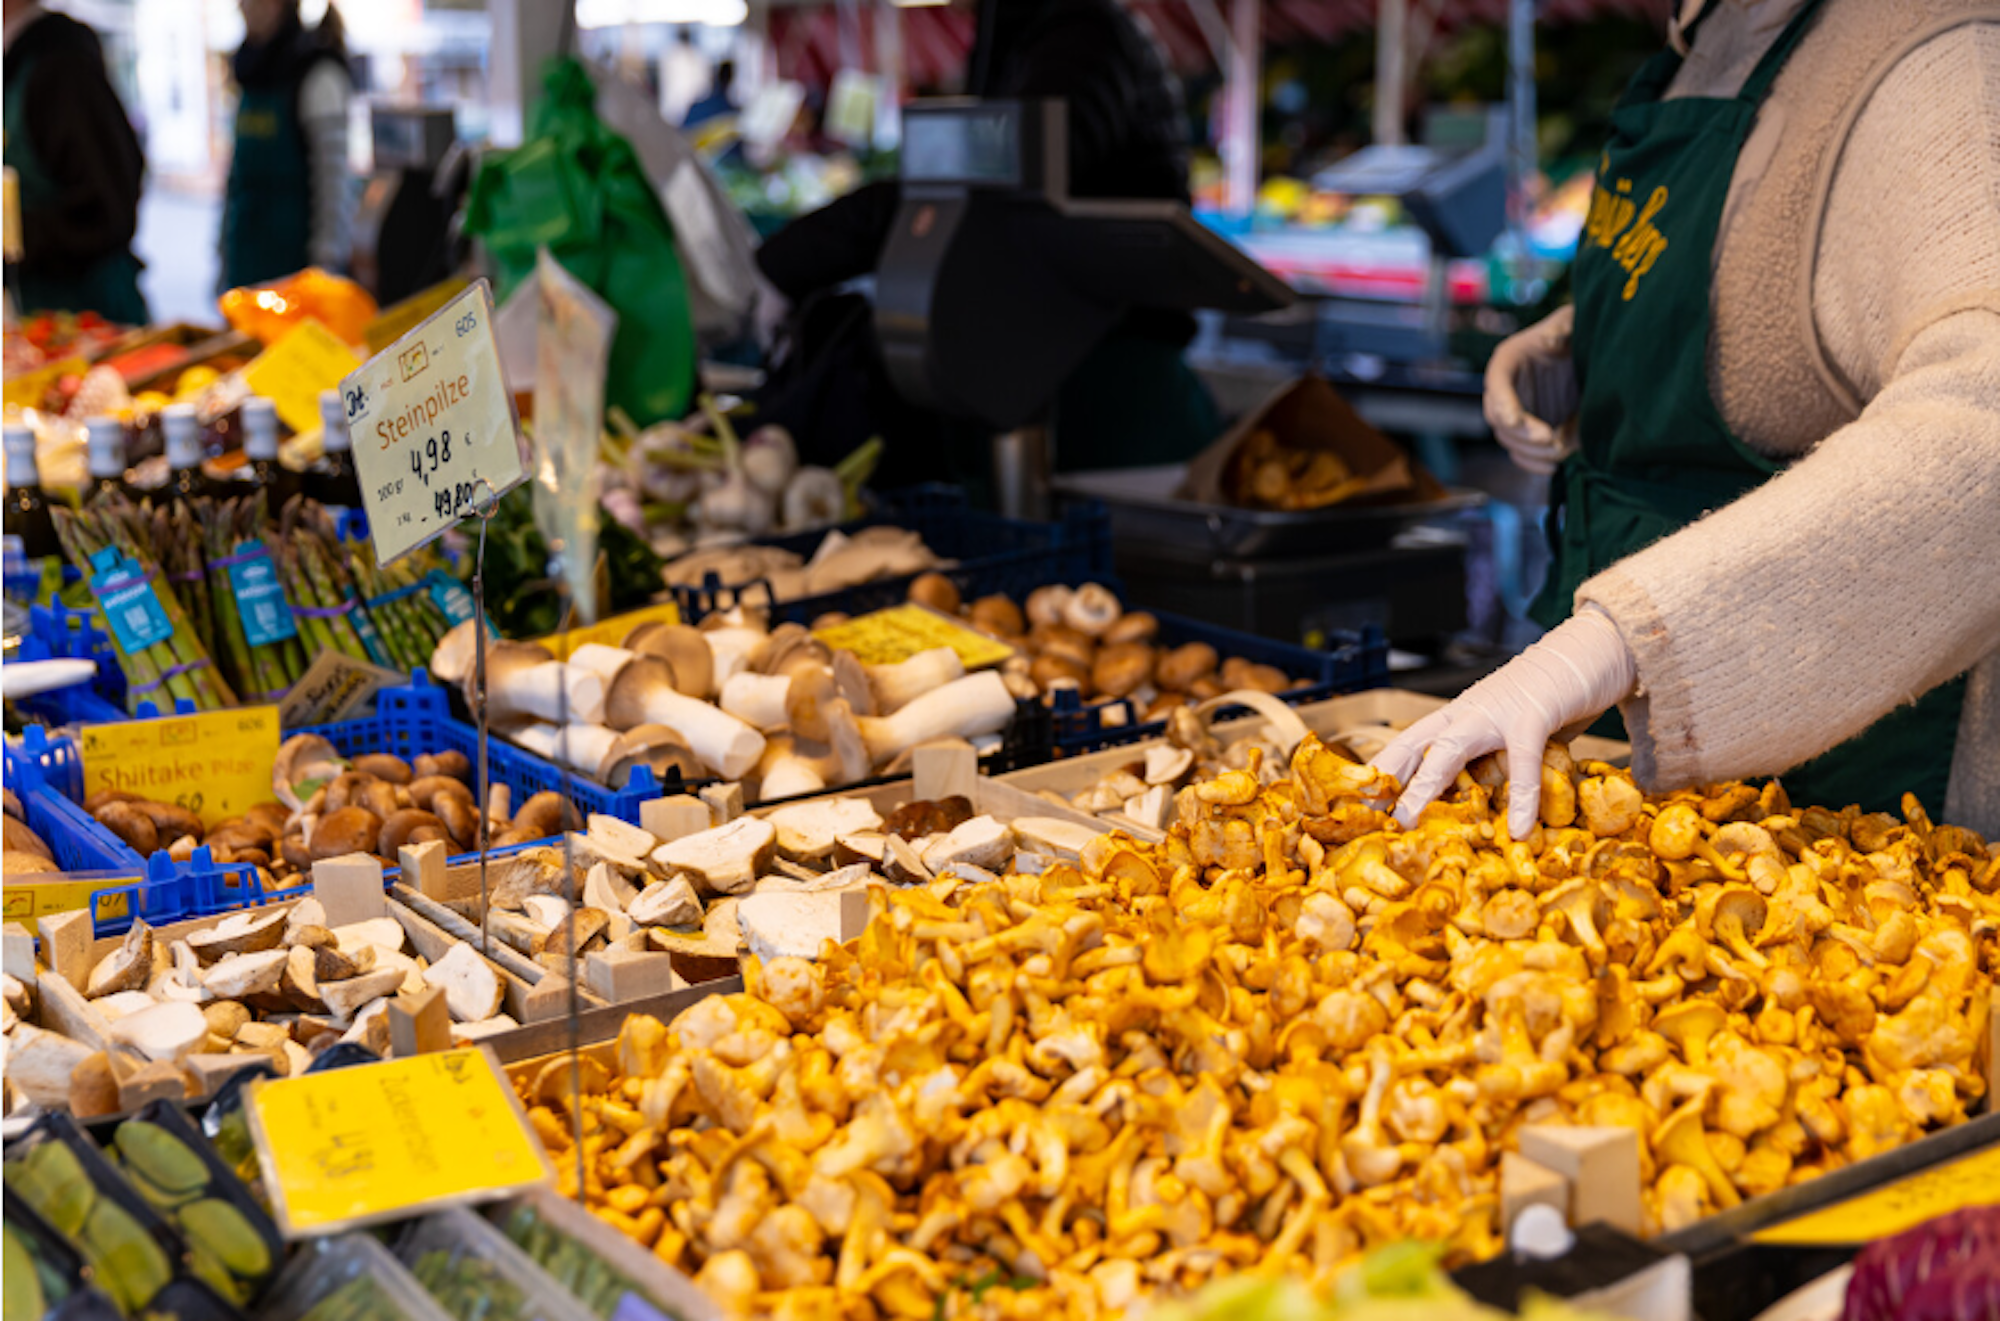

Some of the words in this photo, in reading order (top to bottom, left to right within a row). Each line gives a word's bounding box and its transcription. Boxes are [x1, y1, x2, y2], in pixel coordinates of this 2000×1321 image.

[376, 374, 470, 451] Steinpilze
[410, 430, 451, 488] 4,98
[100, 757, 203, 790] Shiitake
